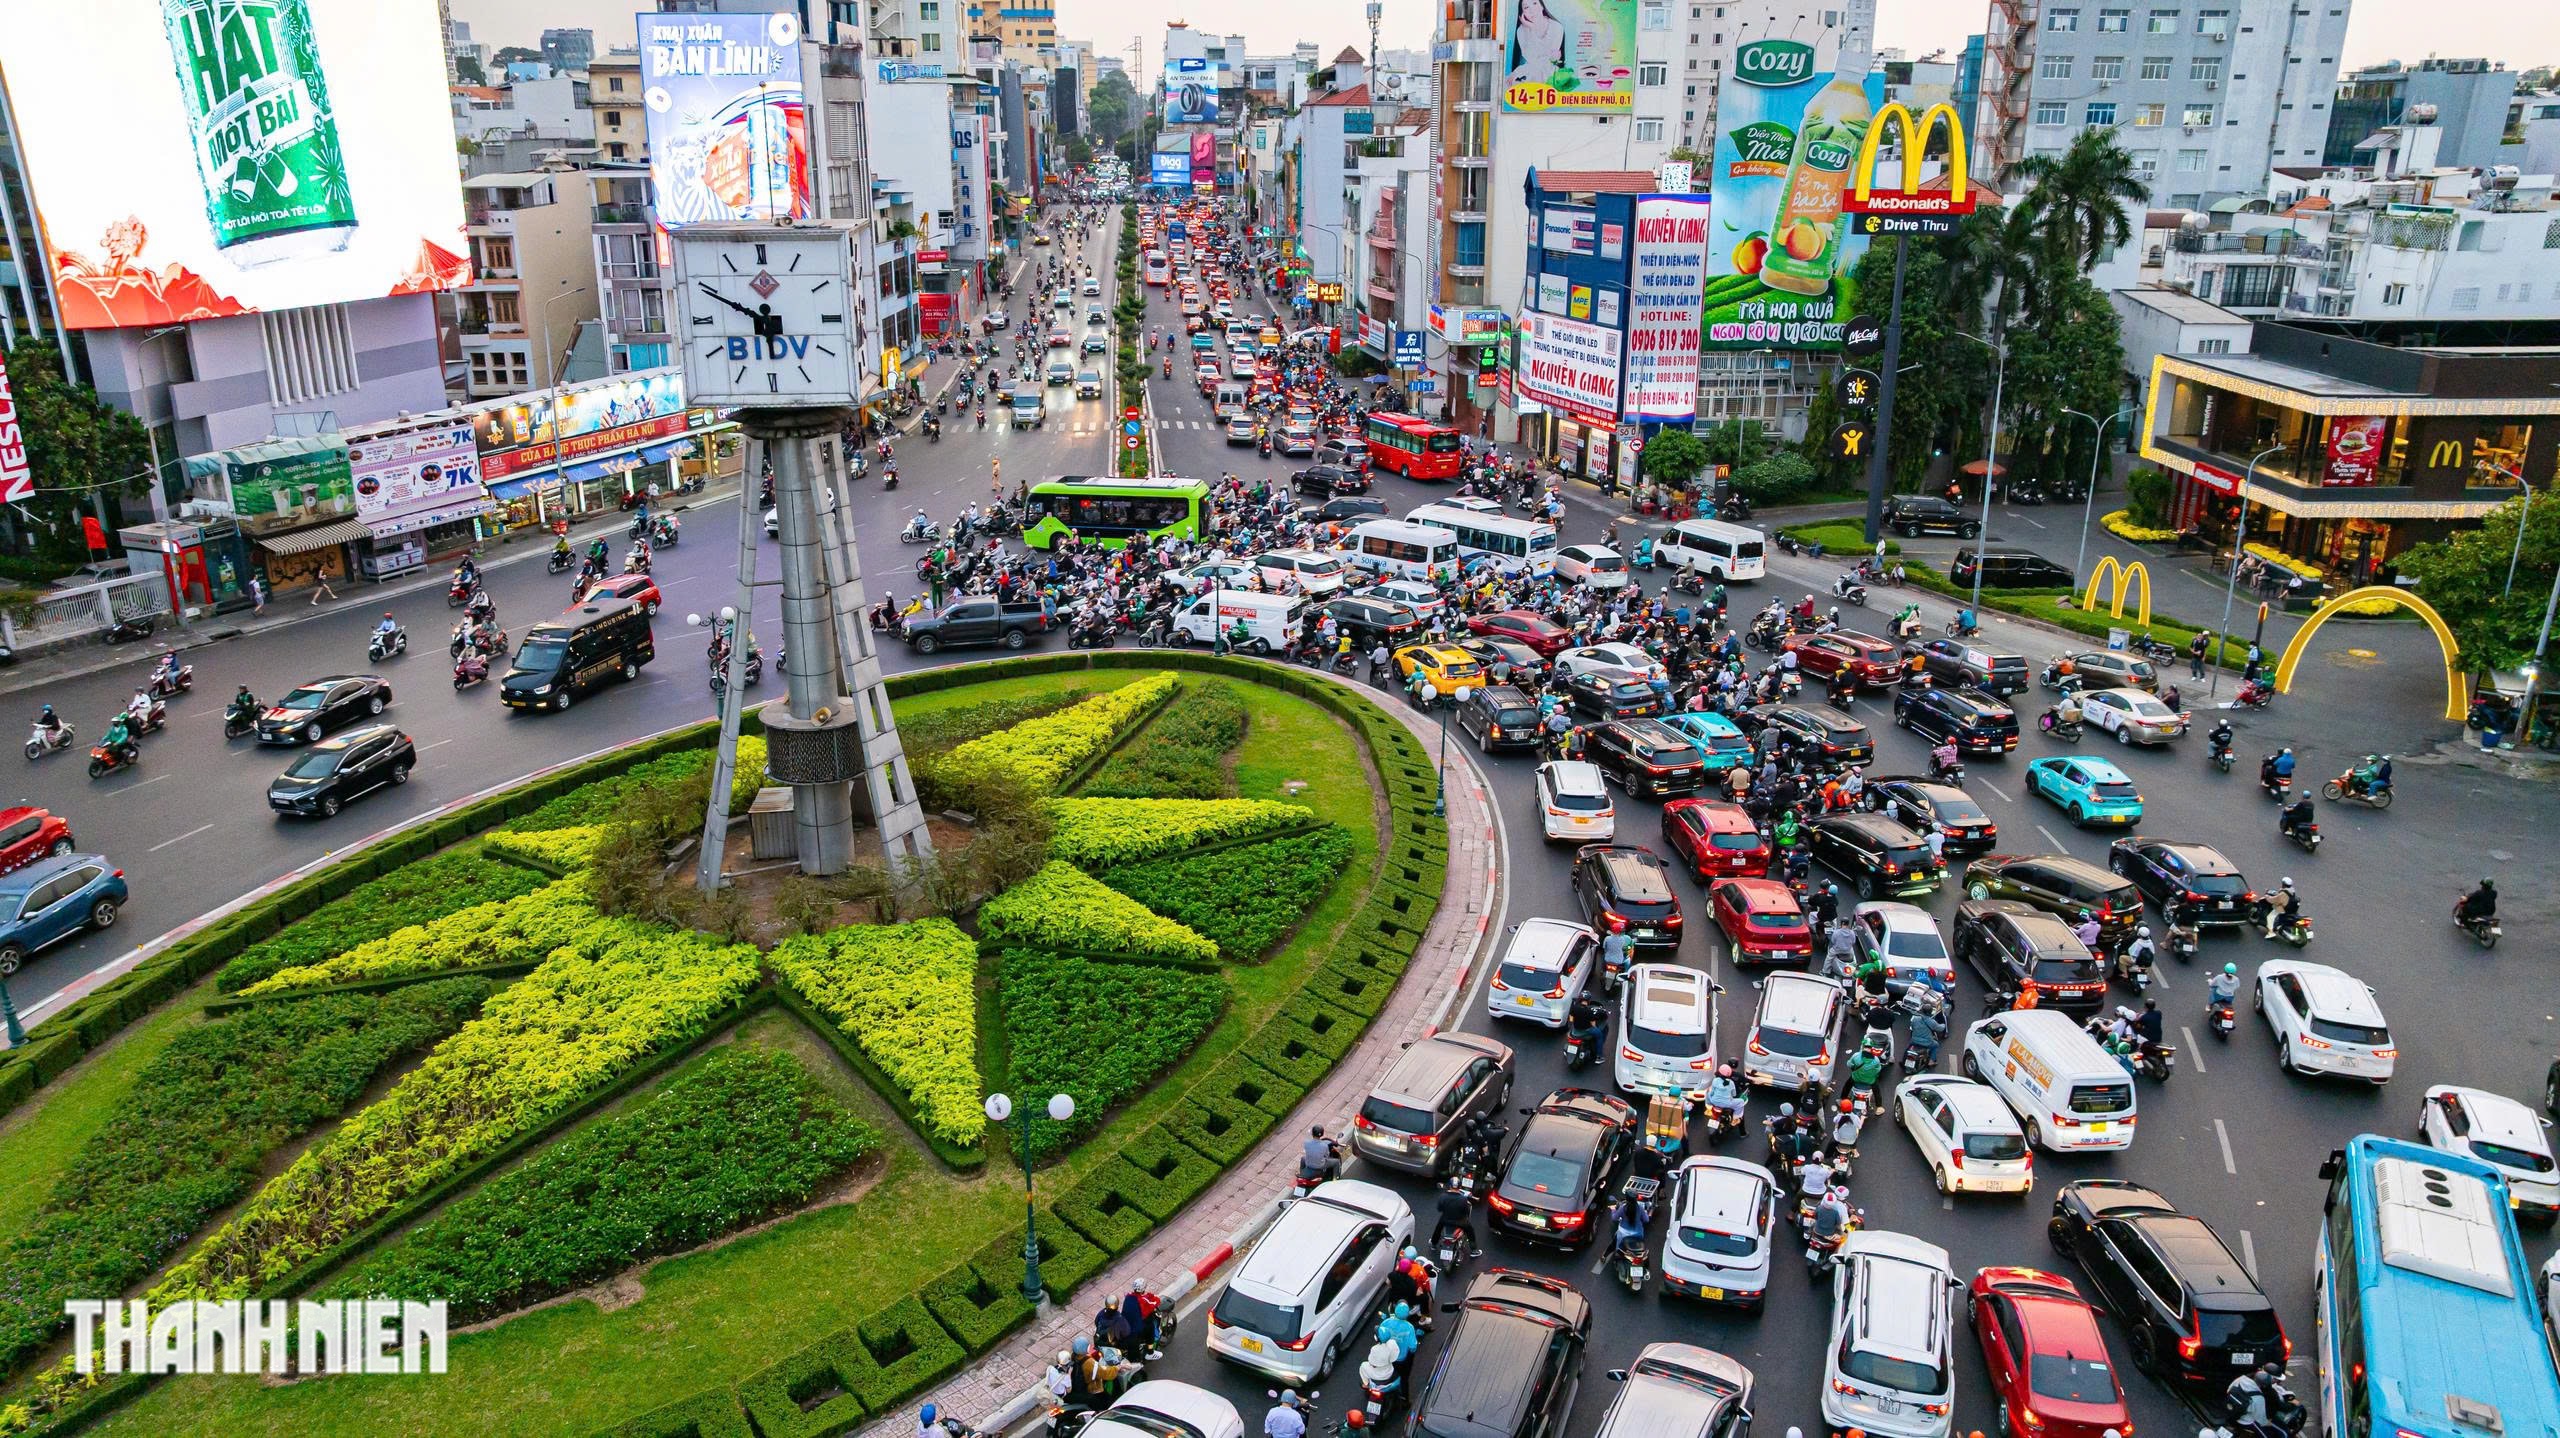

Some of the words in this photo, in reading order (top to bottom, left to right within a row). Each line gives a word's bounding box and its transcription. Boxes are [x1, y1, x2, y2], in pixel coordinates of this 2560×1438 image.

[1744, 47, 1806, 77] Cozy
[1508, 88, 1556, 105] 14-16
[1561, 95, 1580, 106] ĐIỆN
[1581, 94, 1598, 105] BIÊN
[256, 89, 299, 136] BÀI
[1746, 140, 1790, 161] Mới
[1809, 144, 1848, 168] Cozy
[1868, 198, 1950, 210] McDonald's
[1545, 223, 1571, 234] Panasonic
[1638, 209, 1676, 243] NGUYỄN
[1678, 217, 1706, 243] GIANG
[1884, 219, 1919, 231] Drive
[1922, 220, 1948, 231] Thru
[1603, 237, 1621, 245] CADIVI
[1684, 275, 1695, 287] LED
[1690, 295, 1701, 307] TAY
[1739, 299, 1765, 320] TRÀ
[1769, 302, 1797, 320] HOA
[1804, 296, 1834, 320] QUẢ
[1641, 311, 1692, 322] HOTLINE:
[1632, 329, 1656, 351] 0906
[1659, 329, 1677, 351] 819
[1680, 329, 1698, 351] 300
[1712, 325, 1743, 340] NGON
[1749, 321, 1764, 340] RÕ
[1803, 321, 1819, 340] RÕ
[727, 335, 810, 361] BIDV
[1531, 359, 1577, 388] NGUYỄN
[1580, 372, 1615, 399] GIANG
[521, 449, 542, 463] CỬA
[627, 426, 640, 438] HÀ
[641, 421, 656, 438] NỘI
[445, 466, 475, 487] 7K
[1223, 606, 1256, 615] LALAMOVE
[2016, 1044, 2055, 1084] LALAMOVE
